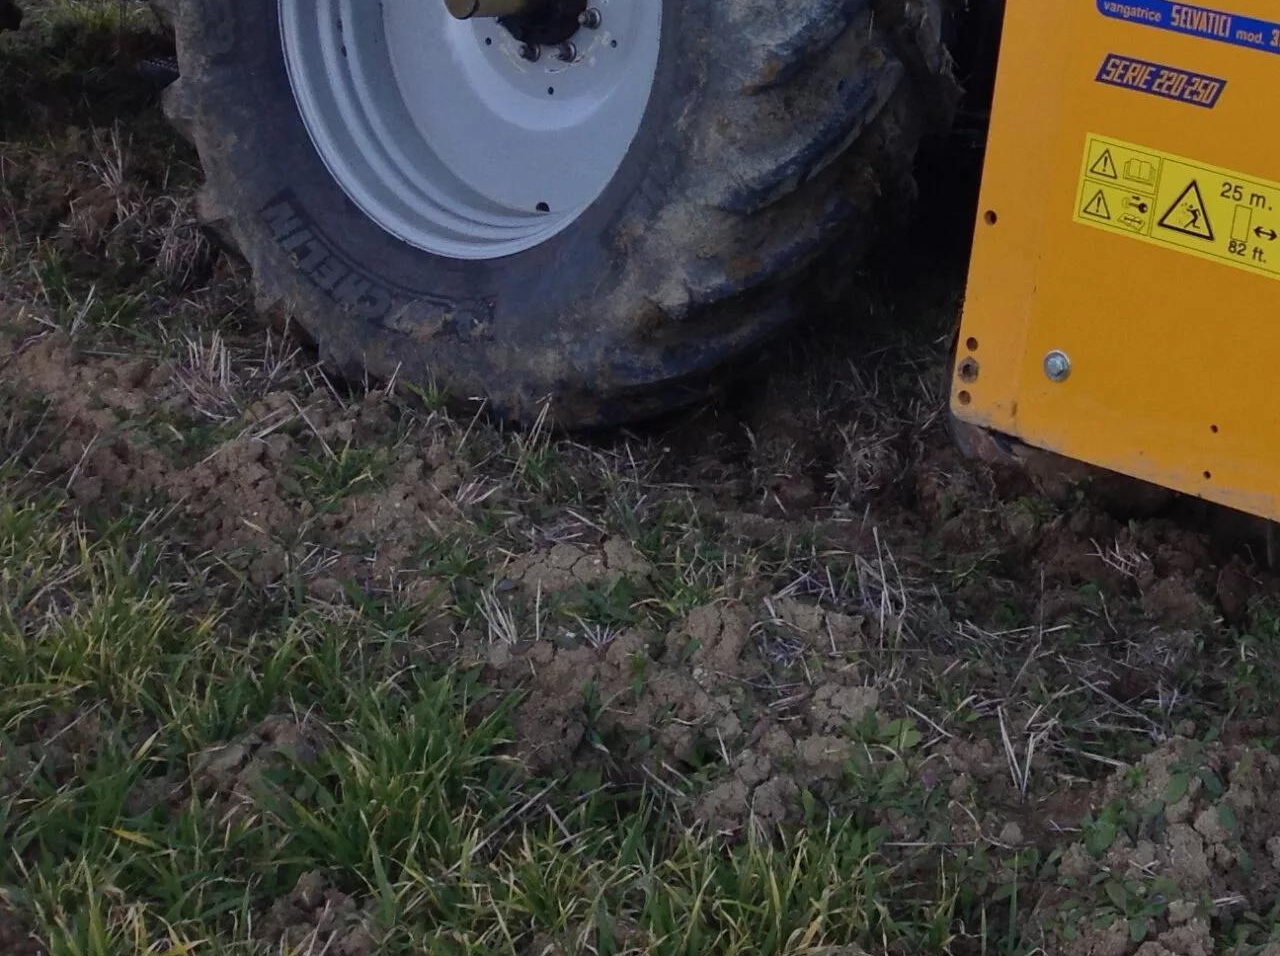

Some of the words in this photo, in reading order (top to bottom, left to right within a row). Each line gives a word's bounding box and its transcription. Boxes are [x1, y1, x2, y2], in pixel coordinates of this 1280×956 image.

[1103, 0, 1162, 23] vangatrice
[1170, 4, 1232, 38] SELVATICI
[1235, 28, 1265, 45] mod.
[1101, 57, 1156, 90] SERIE
[1219, 181, 1244, 202] 25
[1248, 192, 1273, 212] m.
[1227, 239, 1248, 257] 82
[1251, 246, 1267, 264] ft.
